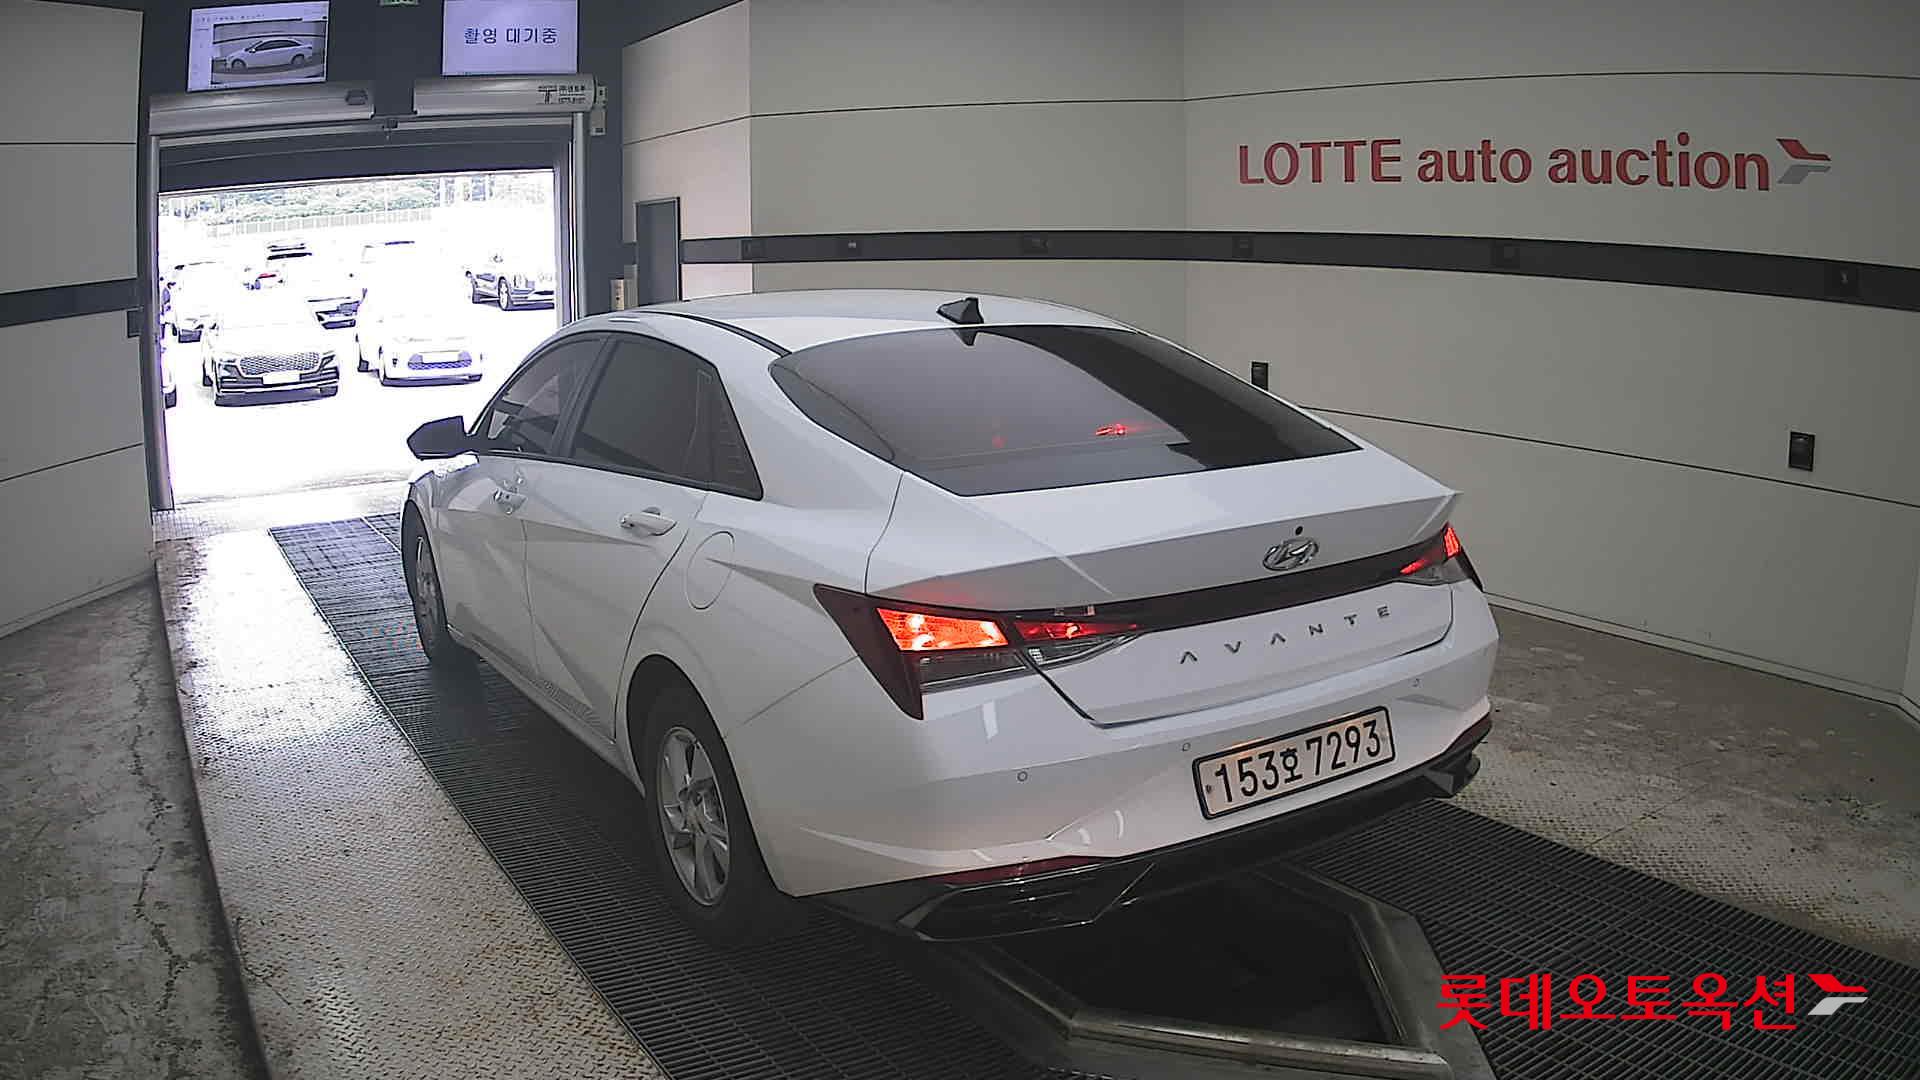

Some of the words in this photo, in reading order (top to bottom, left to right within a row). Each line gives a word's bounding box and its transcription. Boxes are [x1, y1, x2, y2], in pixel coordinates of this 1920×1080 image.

[464, 27, 497, 45] 촬영
[506, 27, 558, 45] 대기중
[1238, 138, 1401, 186] LOTTE
[1416, 139, 1532, 184] auto
[1547, 132, 1770, 191] auction
[1179, 605, 1391, 665] AVANTE
[1214, 747, 1303, 803] 153호
[1305, 718, 1382, 777] 7293
